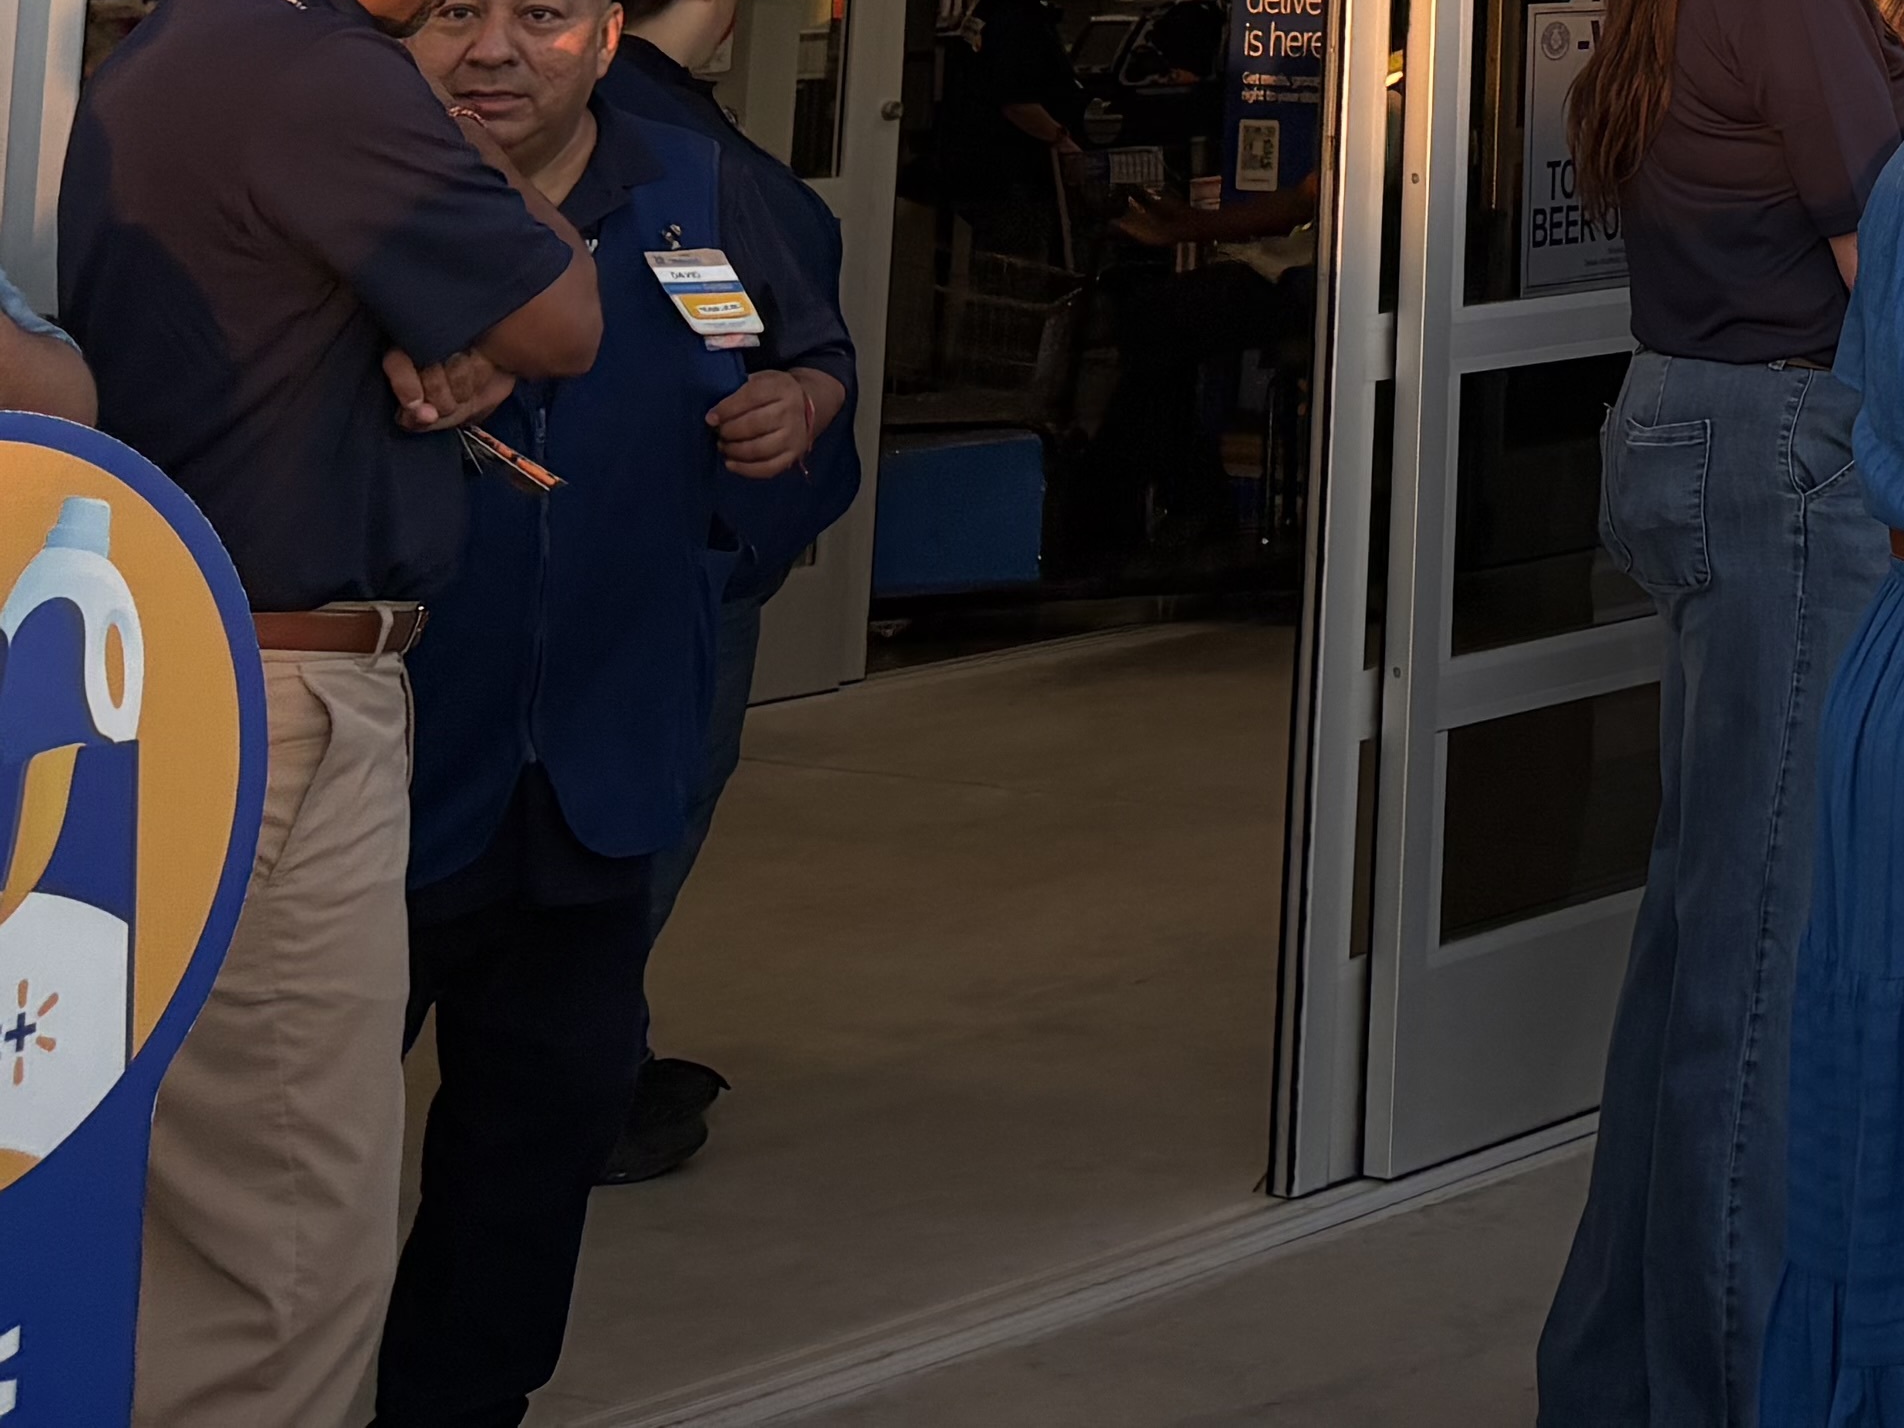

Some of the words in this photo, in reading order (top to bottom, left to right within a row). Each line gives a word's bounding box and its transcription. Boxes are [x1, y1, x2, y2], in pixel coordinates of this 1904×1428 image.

[1244, 22, 1263, 57] is
[1270, 21, 1321, 58] here
[1531, 204, 1596, 248] BEER
